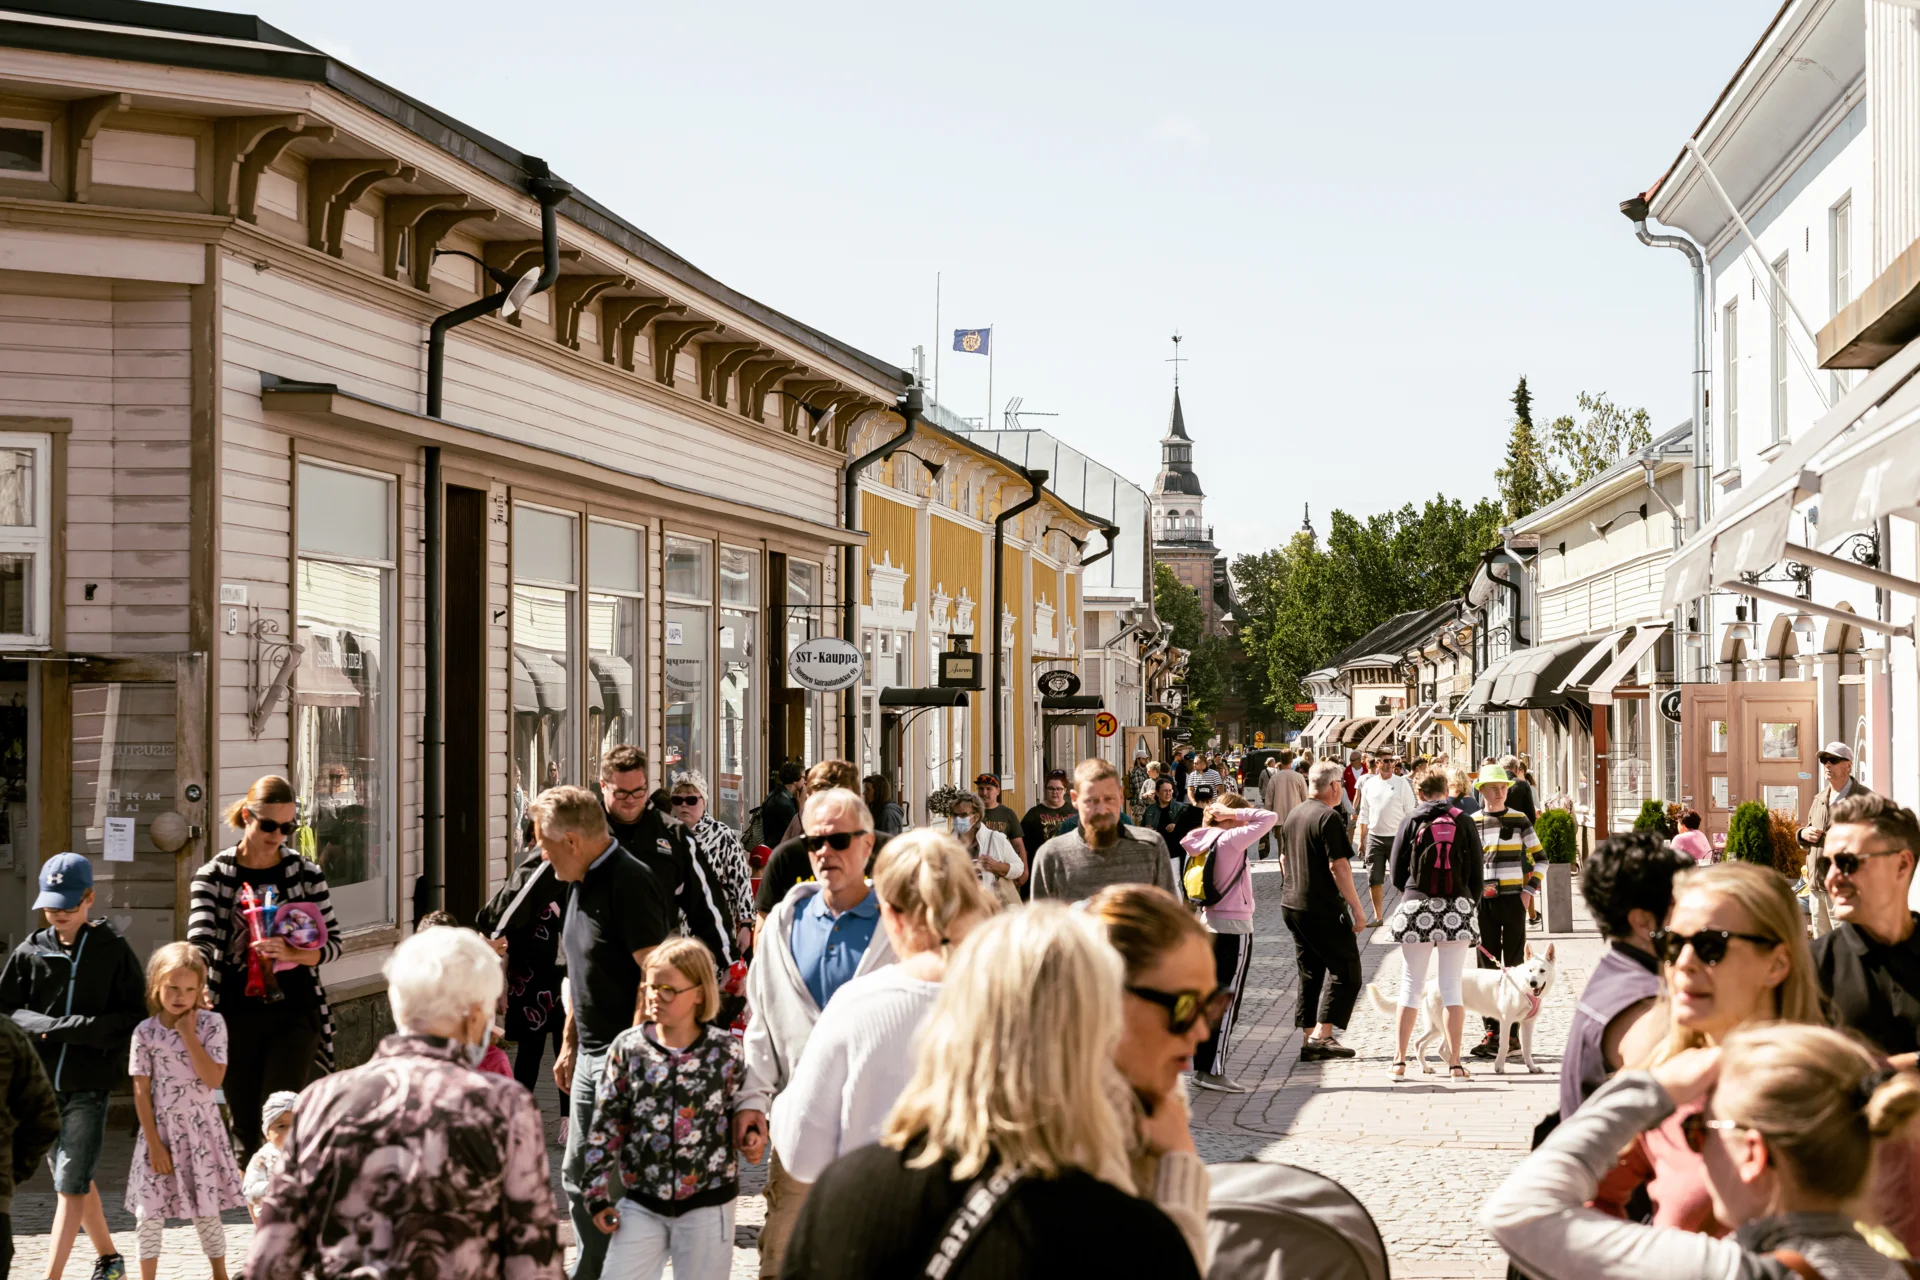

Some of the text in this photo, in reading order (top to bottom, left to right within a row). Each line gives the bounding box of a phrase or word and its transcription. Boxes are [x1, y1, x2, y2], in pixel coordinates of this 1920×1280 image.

[348, 652, 364, 669] IDEA
[948, 663, 972, 674] Aaren
[795, 666, 814, 684] Suomen
[850, 667, 858, 675] Oy
